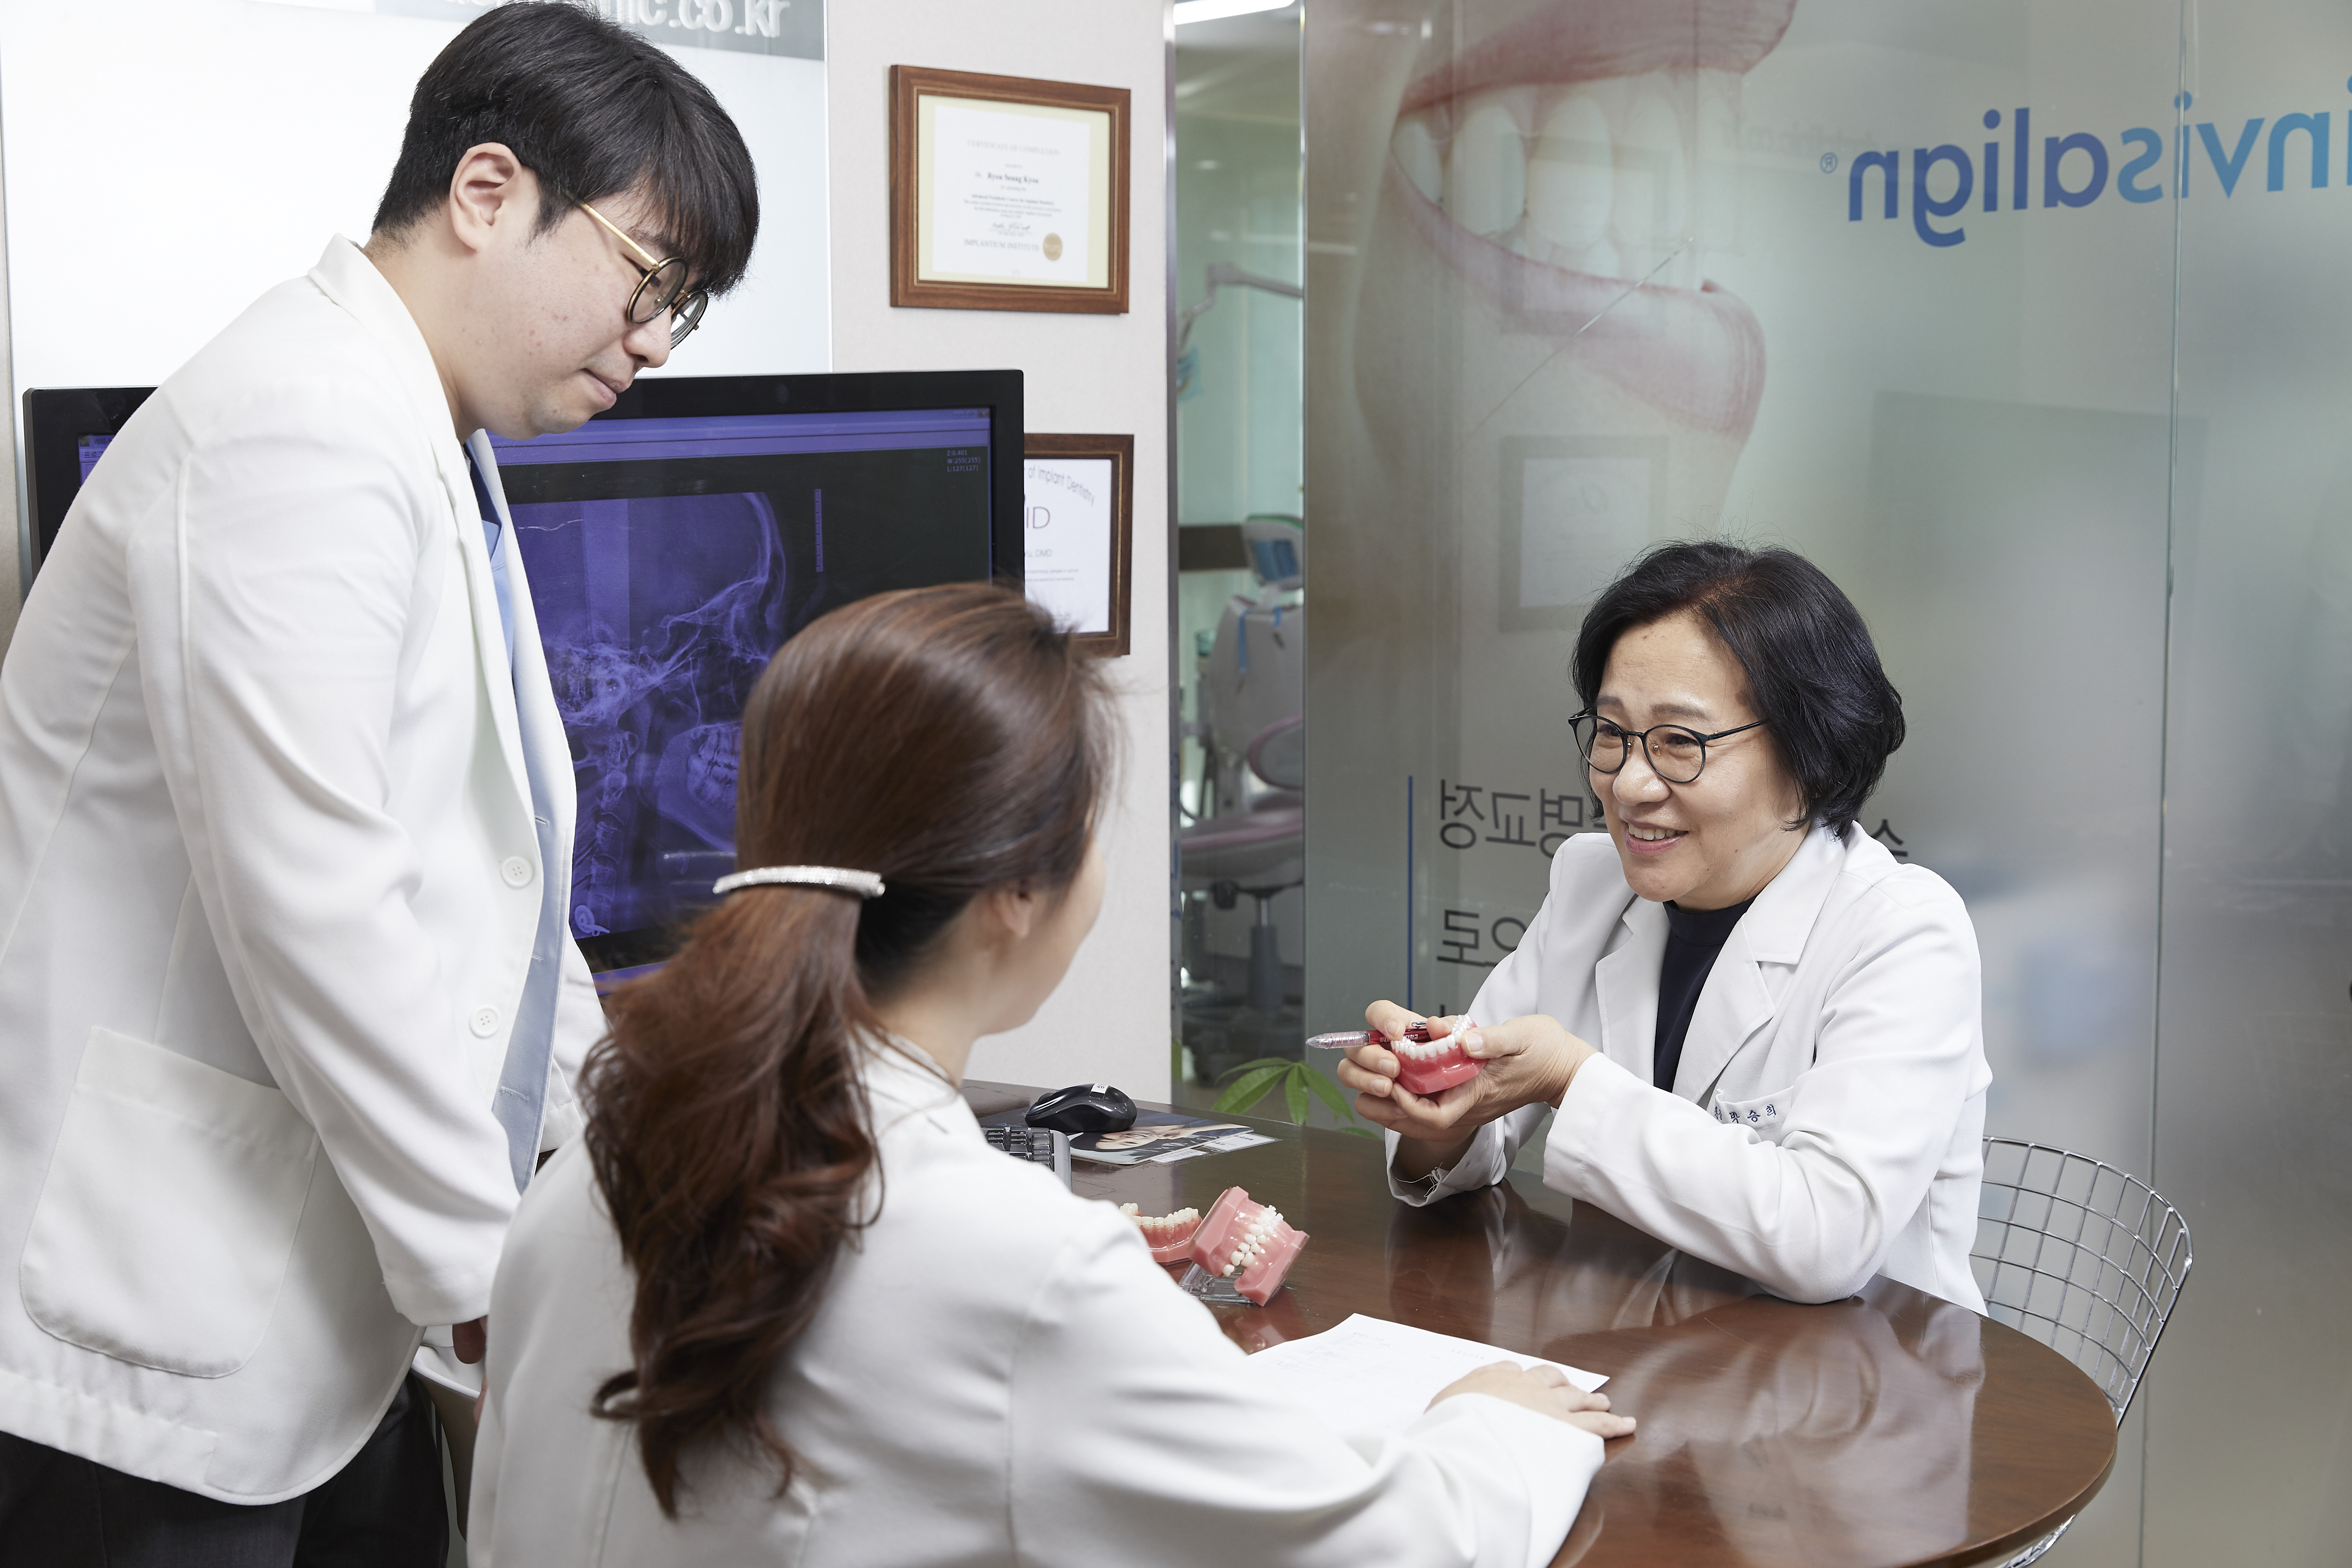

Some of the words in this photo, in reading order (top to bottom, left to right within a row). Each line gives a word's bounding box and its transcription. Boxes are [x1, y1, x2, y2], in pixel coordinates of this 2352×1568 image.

[1028, 464, 1036, 479] of
[1037, 465, 1065, 487] Implant
[1066, 475, 1095, 508] Dentistry
